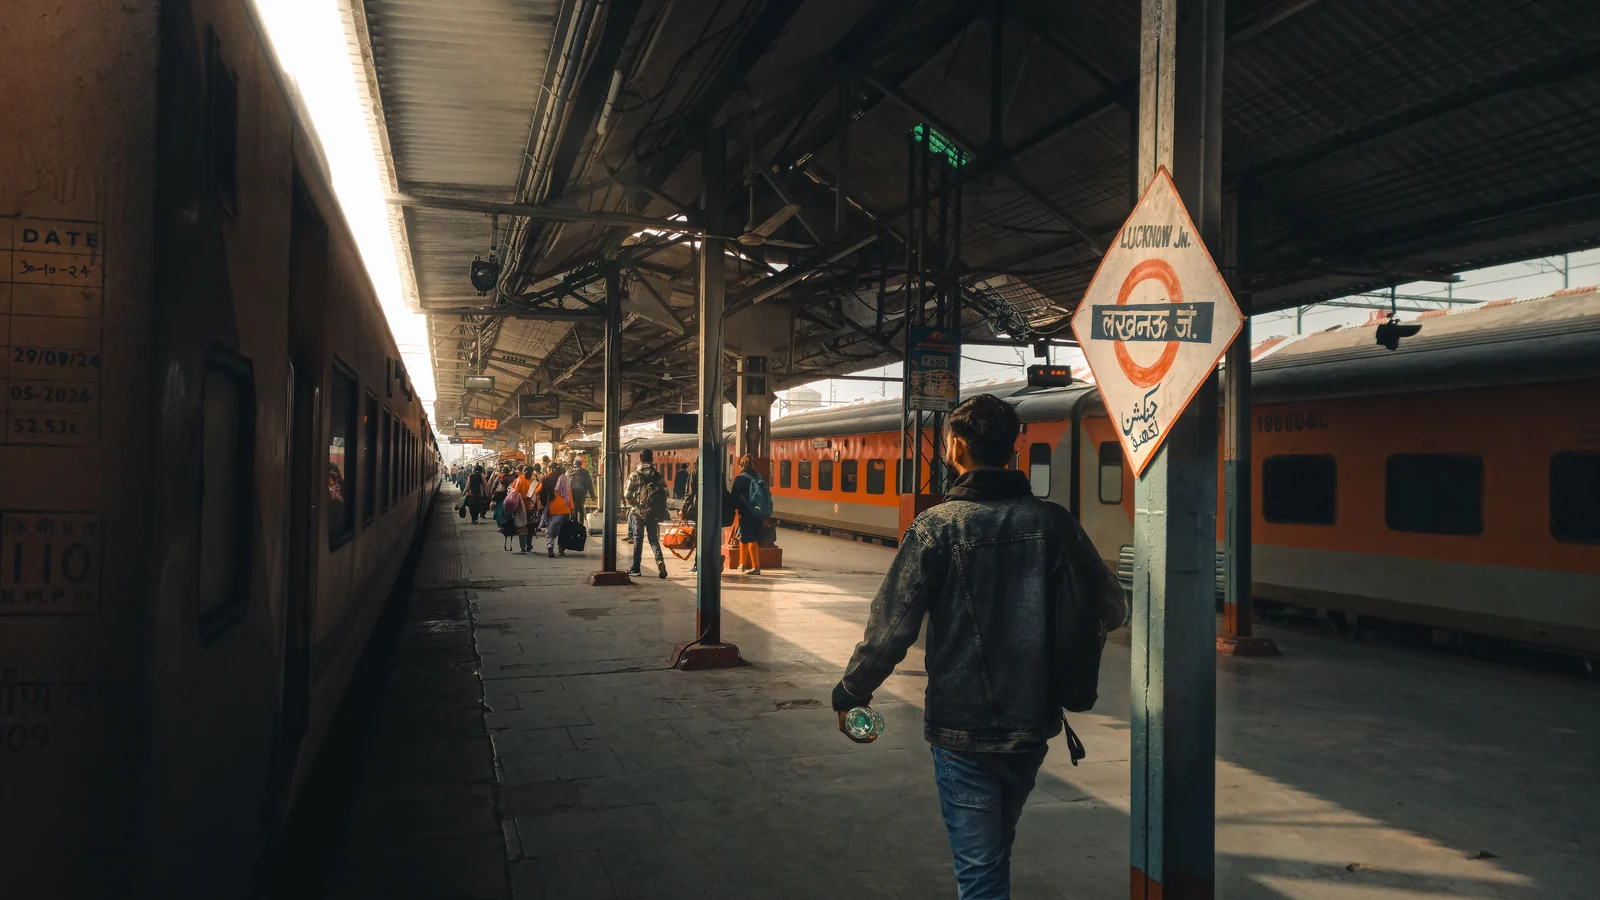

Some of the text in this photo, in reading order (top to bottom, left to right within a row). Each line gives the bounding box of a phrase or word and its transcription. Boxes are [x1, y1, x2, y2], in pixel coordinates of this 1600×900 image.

[22, 228, 98, 248] DATE
[1120, 225, 1173, 249] LUCKNOW
[18, 260, 91, 279] 30-10-24
[1102, 309, 1170, 341] लखनऊ
[10, 385, 92, 404] 05-2026
[13, 418, 78, 434] 52.53t
[473, 417, 498, 430] 14:03
[13, 541, 92, 584] 110
